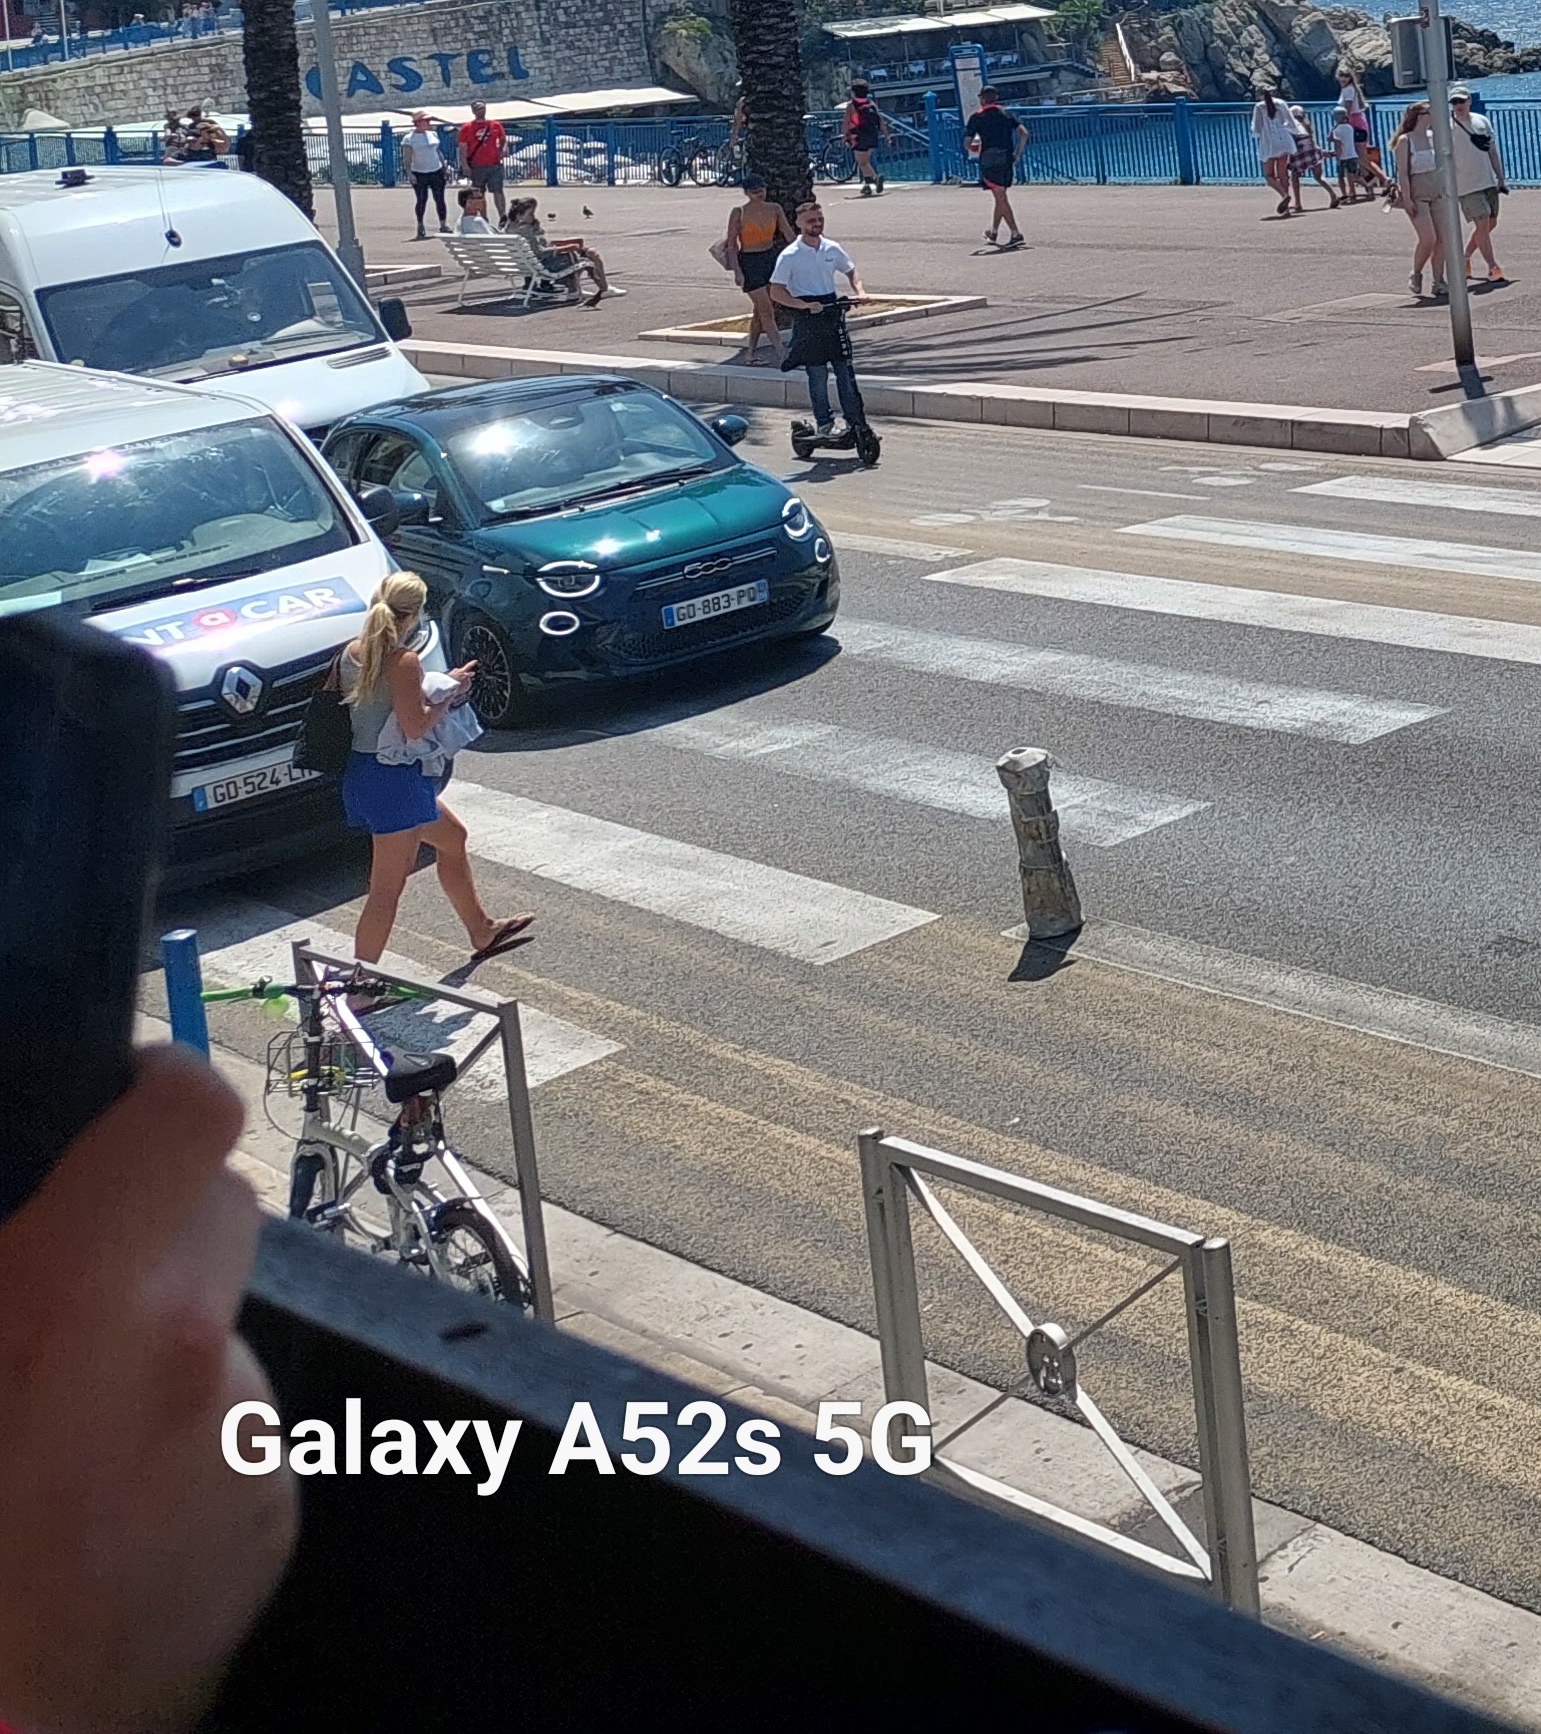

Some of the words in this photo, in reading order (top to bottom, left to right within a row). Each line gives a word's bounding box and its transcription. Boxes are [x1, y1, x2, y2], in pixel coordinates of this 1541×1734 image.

[684, 557, 732, 579] 500
[122, 620, 185, 647] NT
[240, 586, 341, 619] CAR
